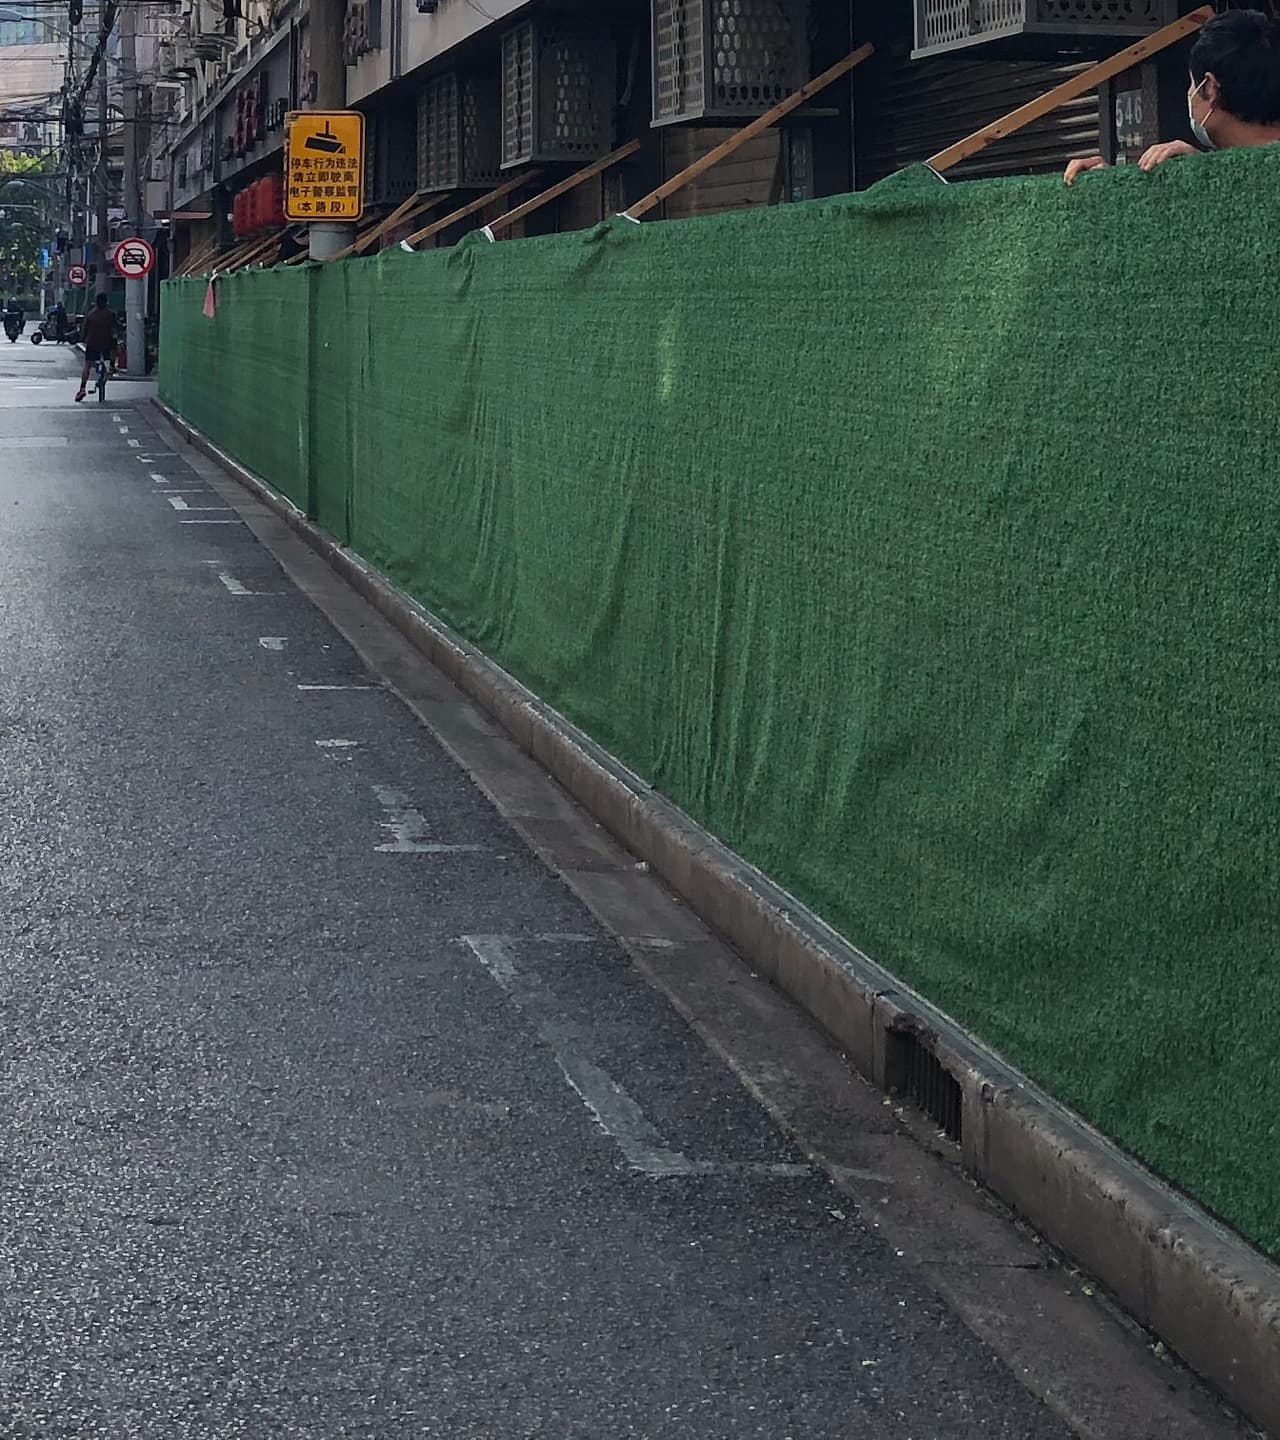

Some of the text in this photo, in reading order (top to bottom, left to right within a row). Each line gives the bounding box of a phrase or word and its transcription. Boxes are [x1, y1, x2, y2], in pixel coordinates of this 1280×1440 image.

[291, 157, 358, 169] 停车行为违法
[293, 171, 354, 183] 请立即驶离
[289, 185, 358, 198] 电子警察监管
